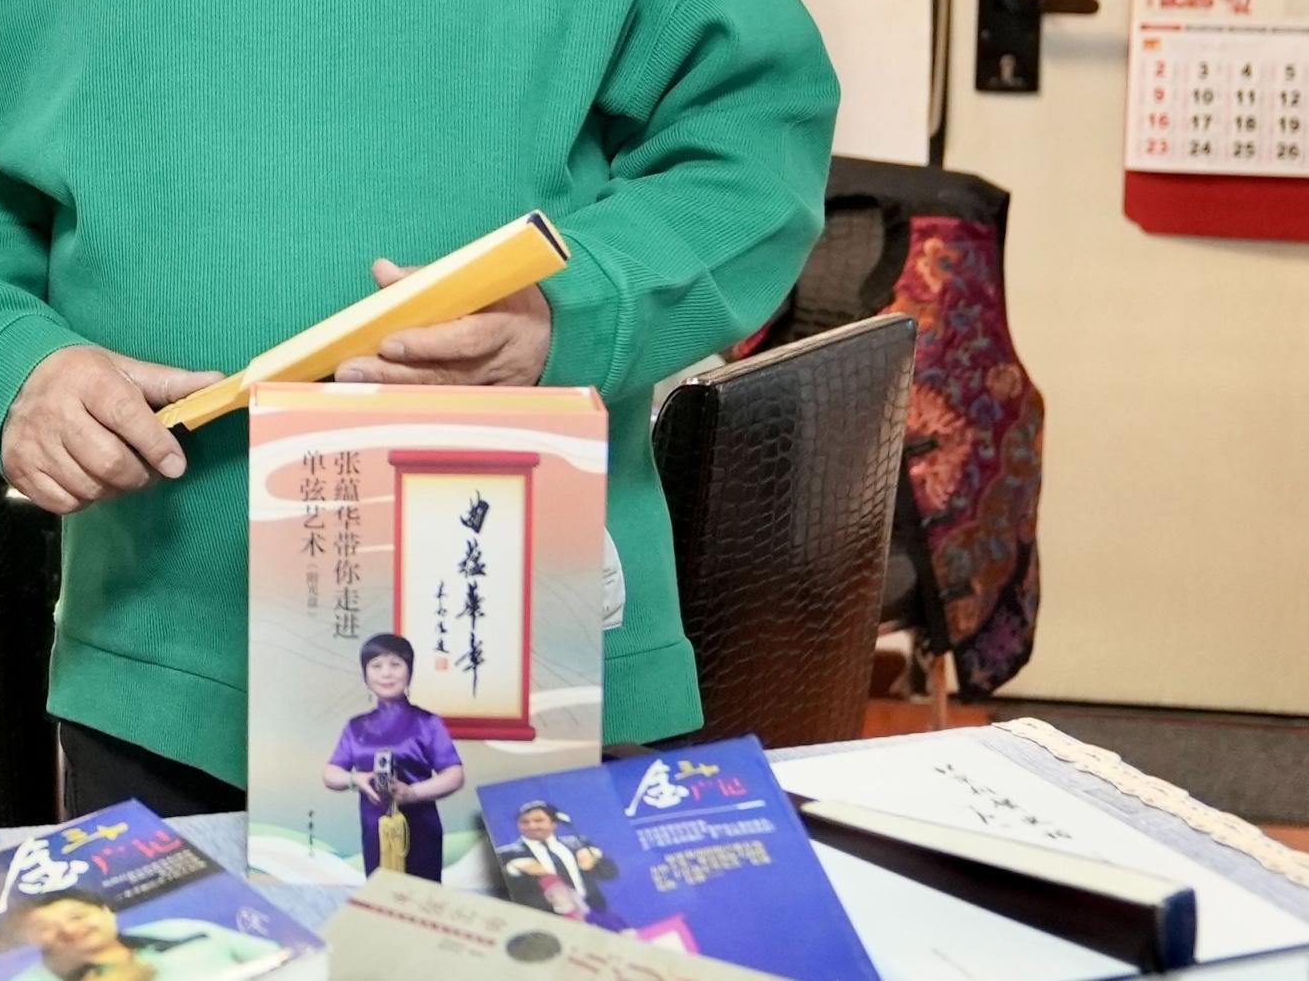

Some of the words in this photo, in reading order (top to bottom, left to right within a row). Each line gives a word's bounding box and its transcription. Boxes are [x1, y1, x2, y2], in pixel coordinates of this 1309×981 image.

[1155, 60, 1166, 77] 2
[1199, 61, 1209, 79] 3
[1241, 61, 1252, 79] 4
[1285, 63, 1296, 81] 5
[1154, 88, 1165, 103] 9
[1193, 89, 1214, 105] 10
[1236, 89, 1256, 105] 11
[1280, 90, 1301, 107] 12
[1148, 113, 1170, 129] 16
[1192, 114, 1212, 130] 17
[1235, 115, 1256, 131] 18
[1279, 116, 1300, 132] 19
[1146, 138, 1169, 155] 23
[1190, 139, 1211, 157] 24
[1233, 140, 1255, 158] 25
[1277, 141, 1300, 159] 26
[299, 449, 326, 557] 单弦艺术
[333, 450, 361, 640] 张蕴华带你走进
